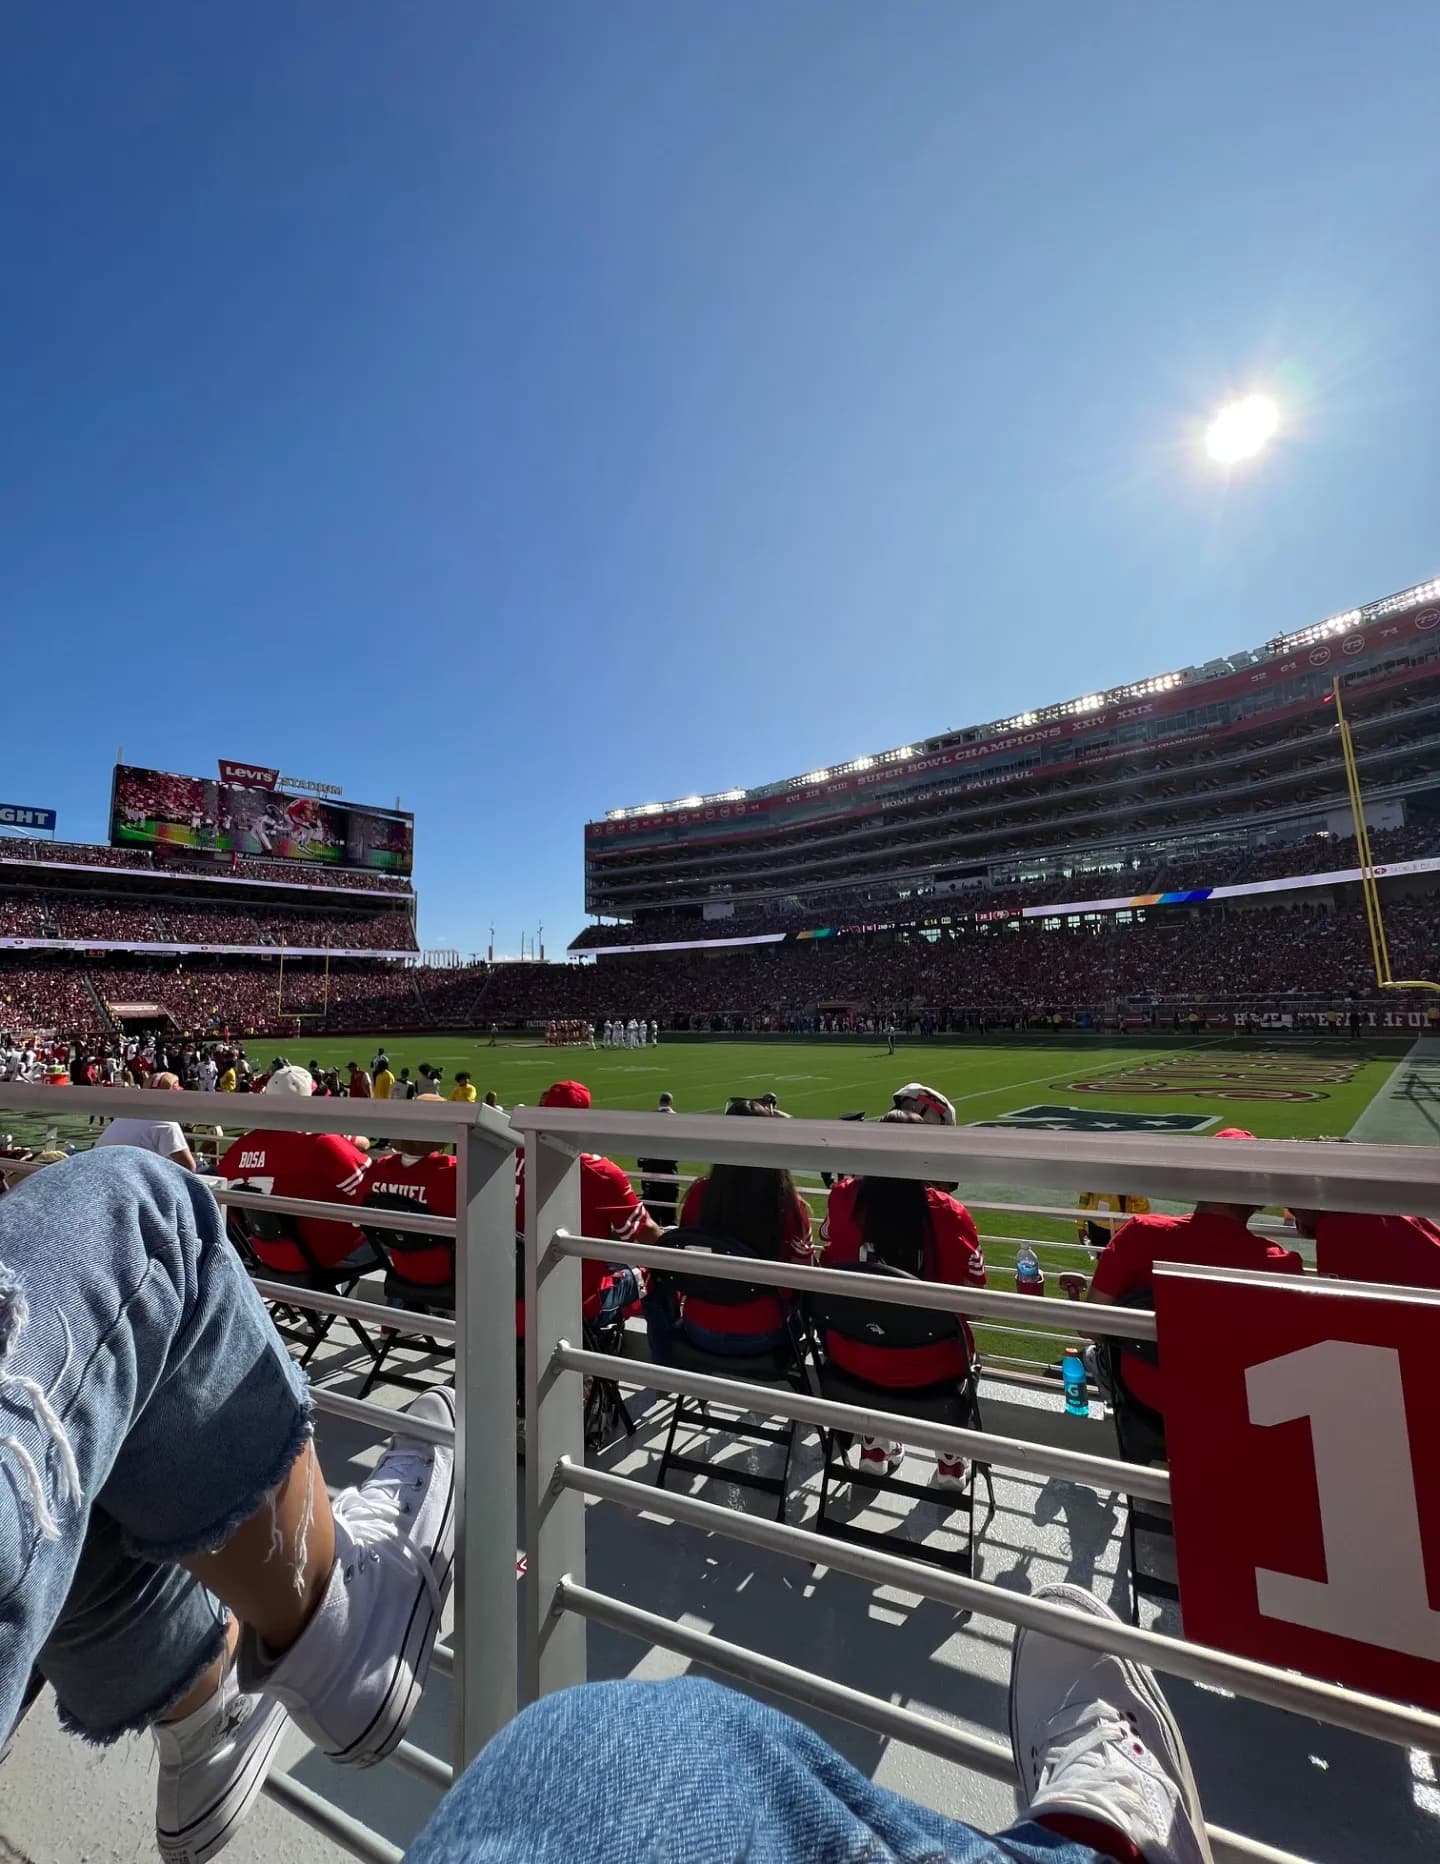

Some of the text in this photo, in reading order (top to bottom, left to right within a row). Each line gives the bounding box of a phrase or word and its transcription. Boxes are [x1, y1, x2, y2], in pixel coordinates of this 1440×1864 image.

[857, 768, 904, 785] SUPER
[907, 757, 952, 773] BOWL
[955, 726, 1062, 760] CHAMPIONS
[1072, 715, 1107, 732] XXIV
[1117, 703, 1153, 720] XXIX
[281, 776, 343, 795] STADIUM
[881, 770, 1034, 809] HOME OF THE FAITHFUL
[0, 808, 48, 825] GHT
[239, 1151, 265, 1168] BOSA
[372, 1181, 427, 1204] SAMUEL
[1068, 1384, 1079, 1397] G
[1244, 1339, 1440, 1663] 1
